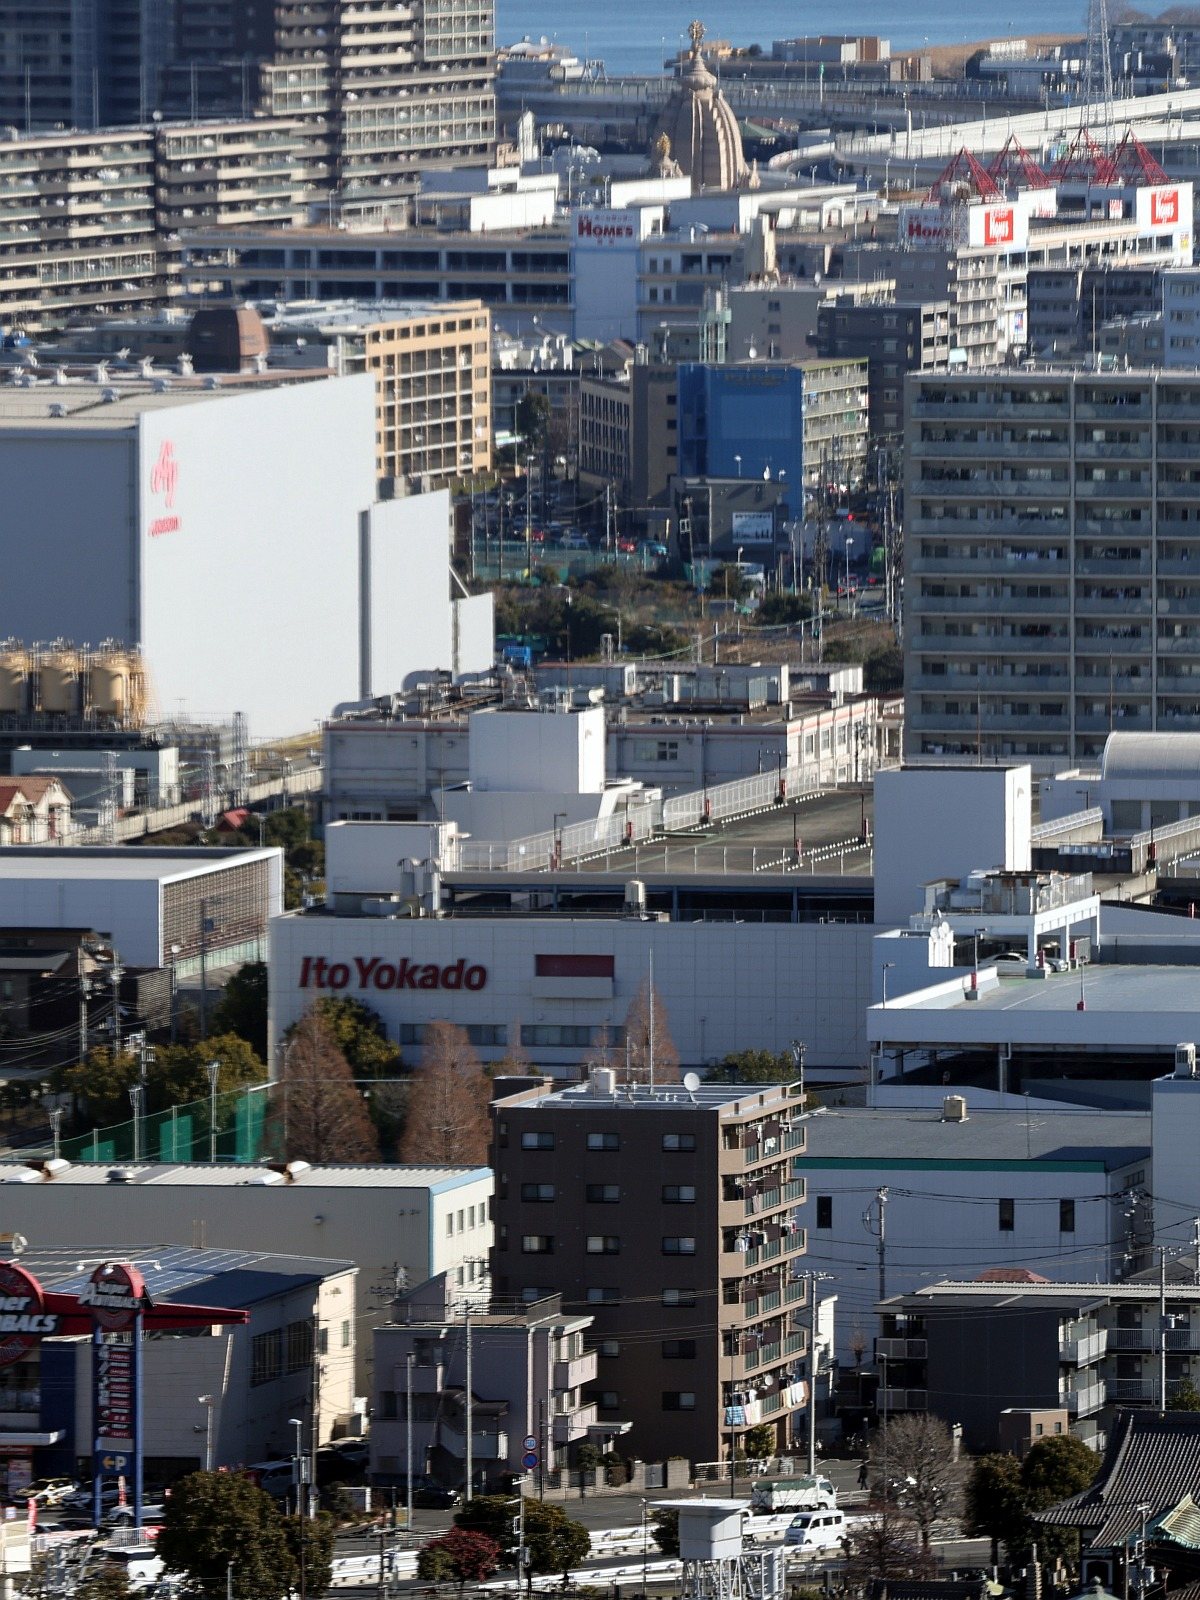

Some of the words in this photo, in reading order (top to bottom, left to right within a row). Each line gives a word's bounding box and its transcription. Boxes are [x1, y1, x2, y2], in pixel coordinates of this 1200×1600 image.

[353, 956, 487, 991] Yokado
[0, 1314, 58, 1332] BACS
[114, 1455, 127, 1471] P
